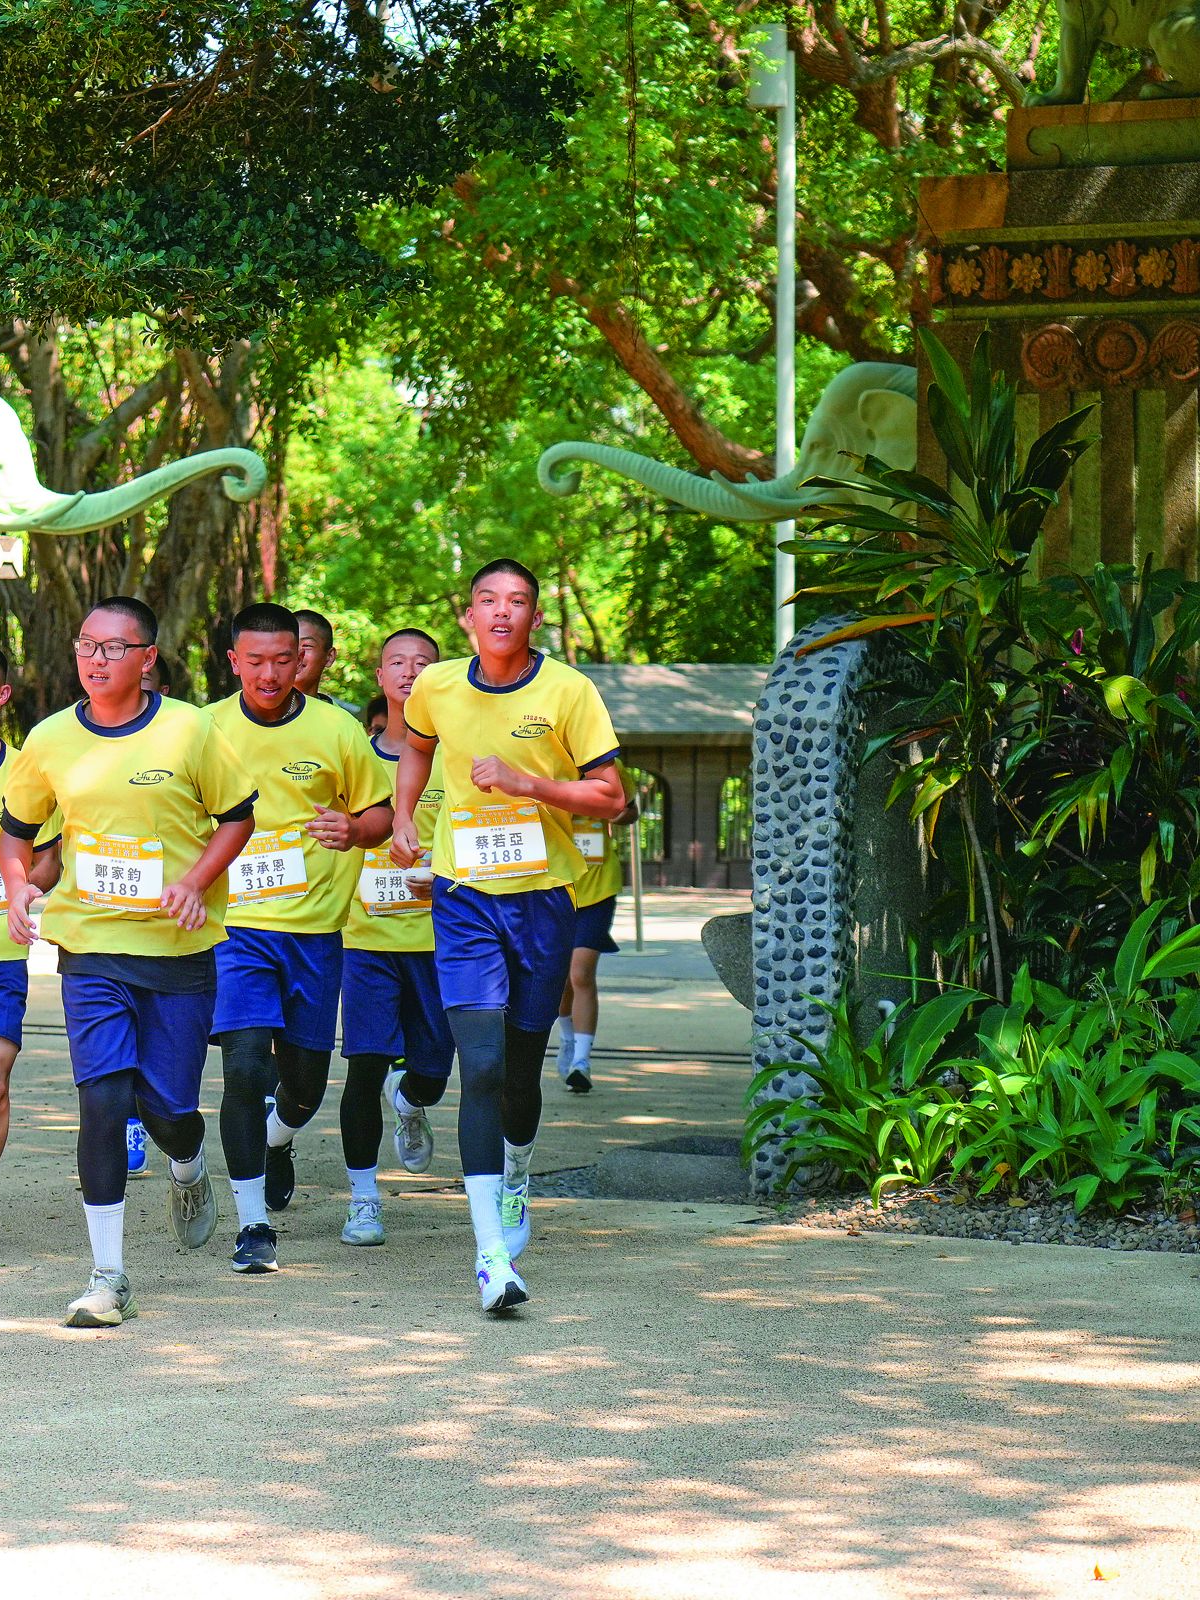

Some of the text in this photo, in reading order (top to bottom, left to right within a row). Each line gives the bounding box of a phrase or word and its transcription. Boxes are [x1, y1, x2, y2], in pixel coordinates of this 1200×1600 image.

[475, 832, 524, 850] 蔡若亞
[479, 848, 523, 865] 3188
[94, 863, 142, 883] 鄭家鈞
[240, 858, 286, 877] 蔡承恩
[97, 880, 139, 897] 3189
[245, 874, 285, 891] 3187
[375, 875, 416, 889] 柯翔
